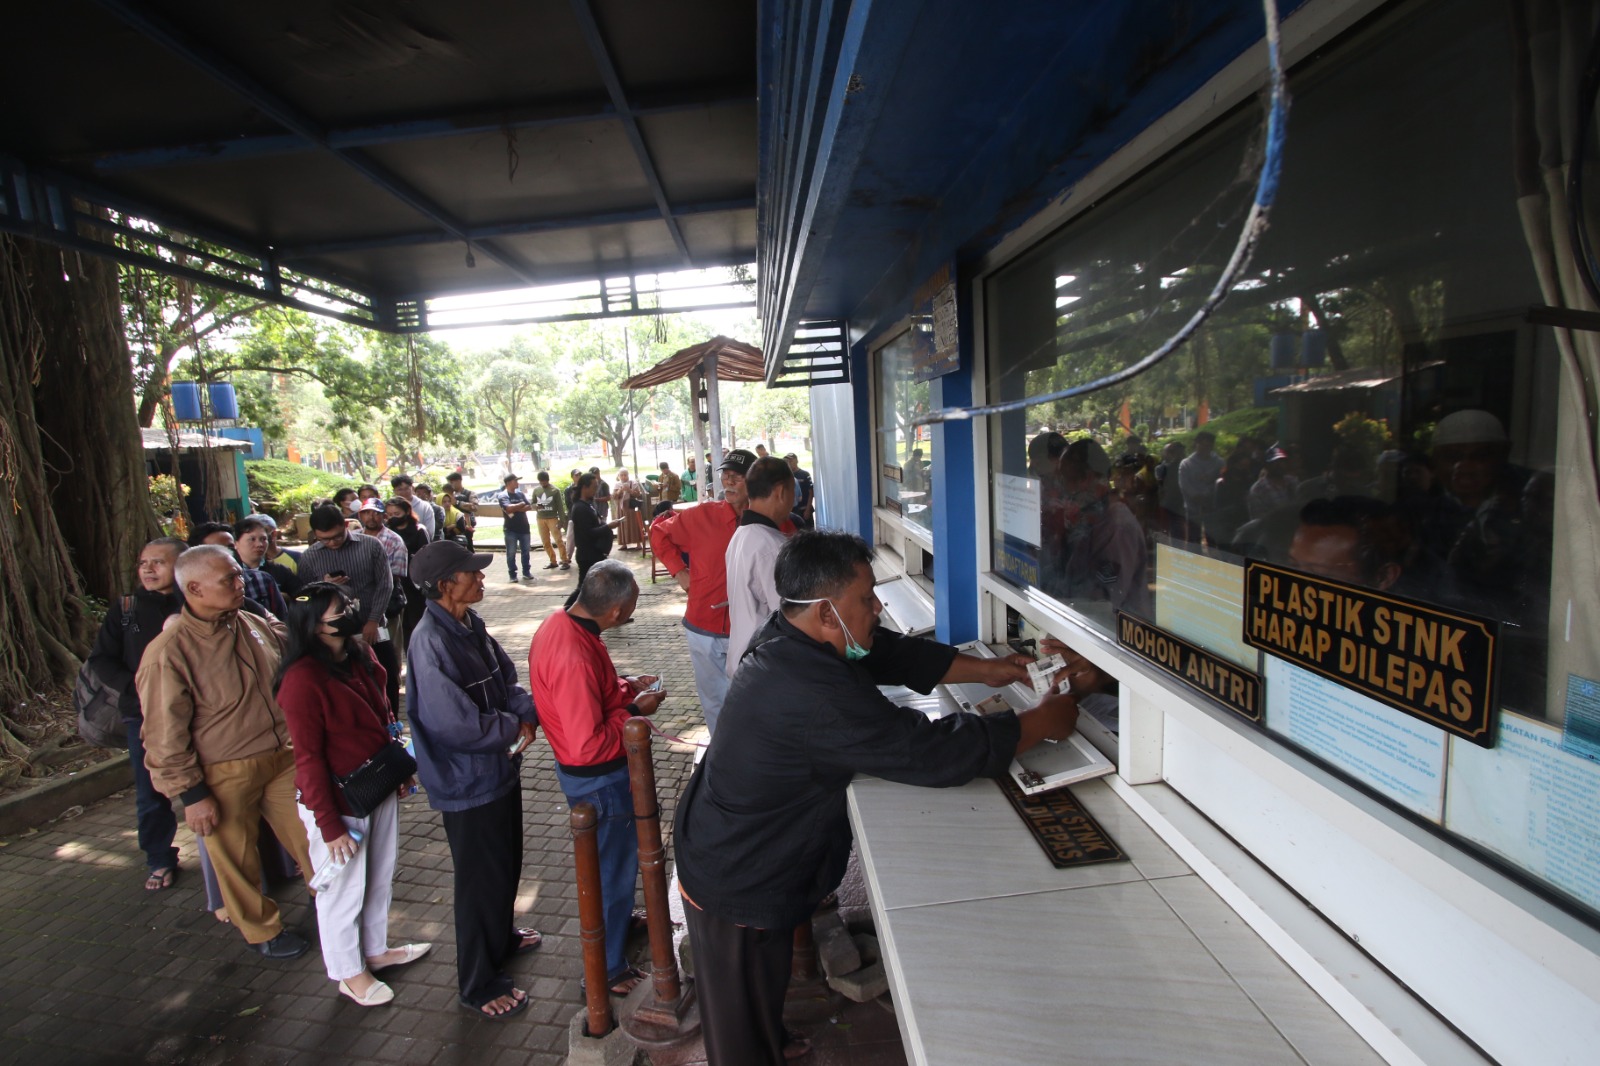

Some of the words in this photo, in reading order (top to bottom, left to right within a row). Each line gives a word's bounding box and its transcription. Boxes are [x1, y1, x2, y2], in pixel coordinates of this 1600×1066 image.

[1260, 573, 1365, 637] PLASTIK
[1373, 606, 1467, 672] STNK
[1122, 619, 1181, 671] MOHON
[1186, 653, 1253, 711] ANTRI
[1253, 606, 1331, 663] HARAP
[1339, 637, 1473, 722] DILEPAS
[1498, 722, 1537, 741] ARATAN
[1024, 806, 1083, 859] DILEPAS
[1061, 815, 1110, 852] STNK
